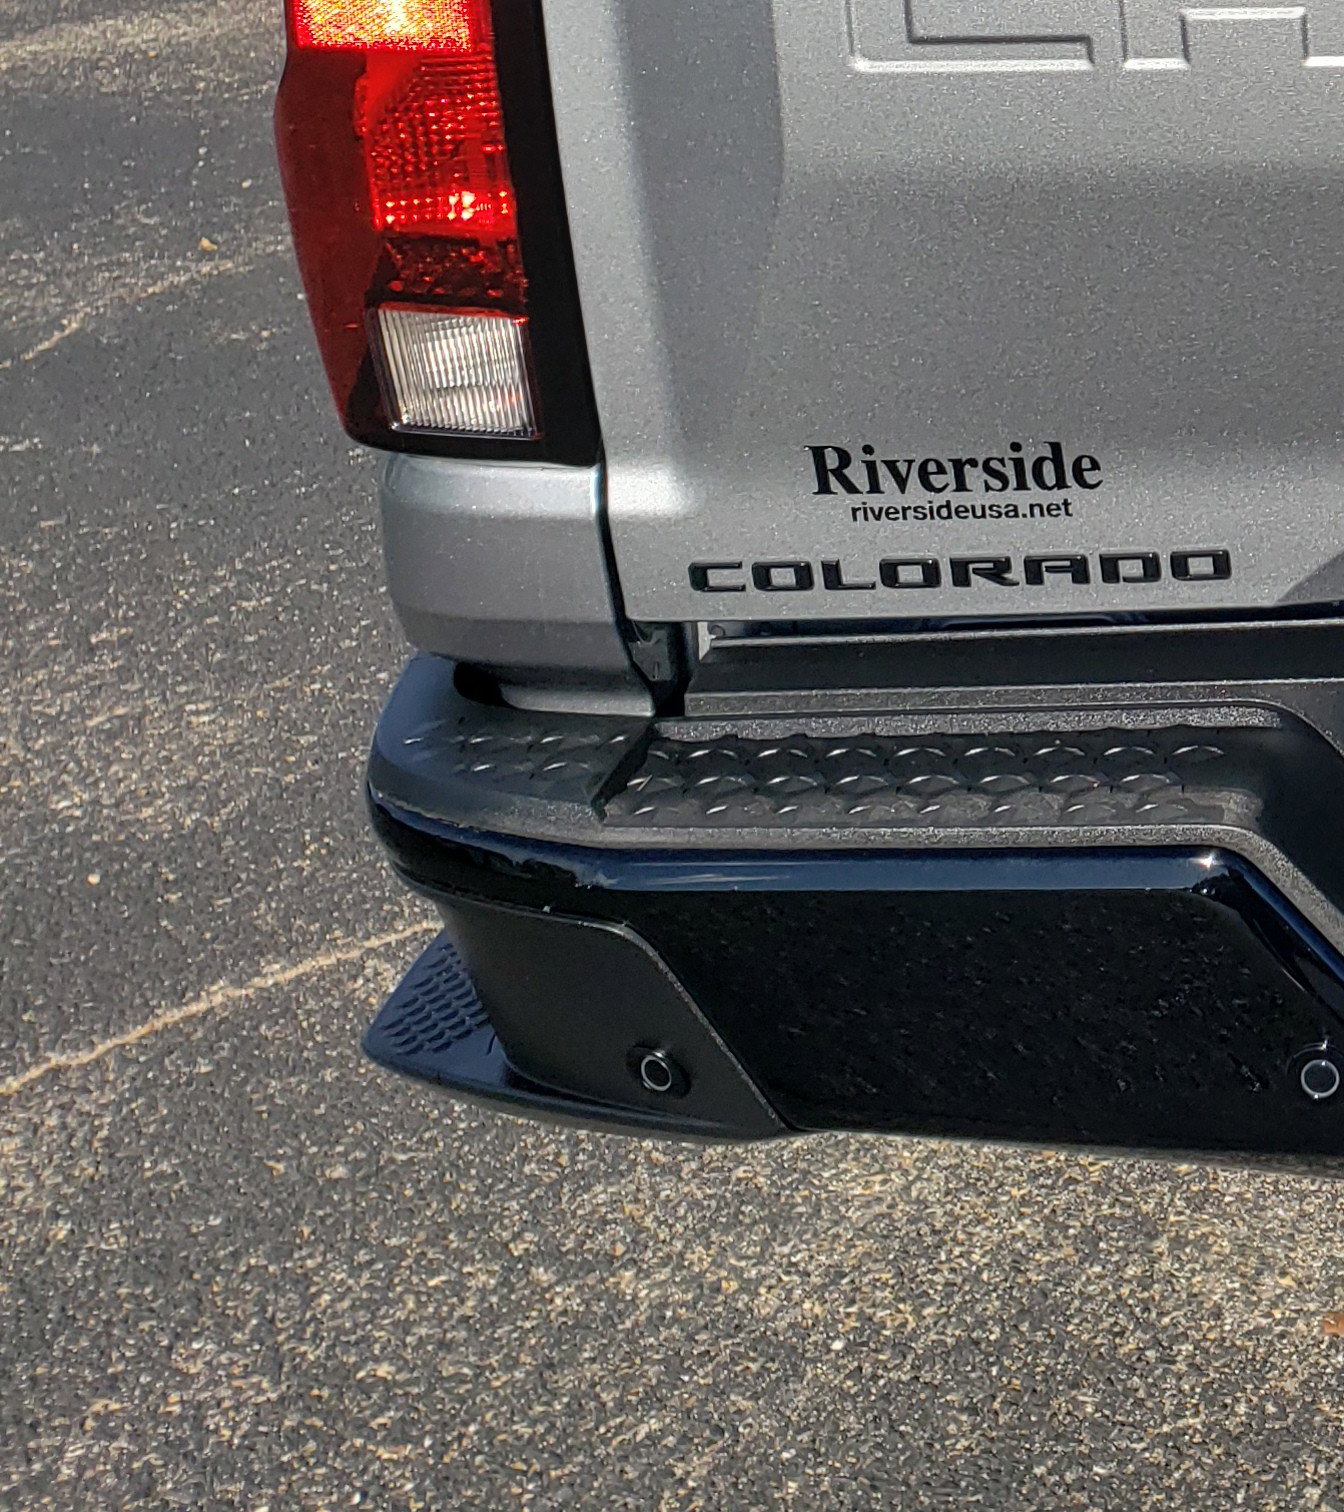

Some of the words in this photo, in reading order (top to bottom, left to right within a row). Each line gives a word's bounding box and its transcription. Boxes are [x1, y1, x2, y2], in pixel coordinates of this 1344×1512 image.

[803, 440, 1104, 496] Riverside
[850, 497, 1074, 523] riversideusa.net
[687, 547, 1232, 594] COLORADO
